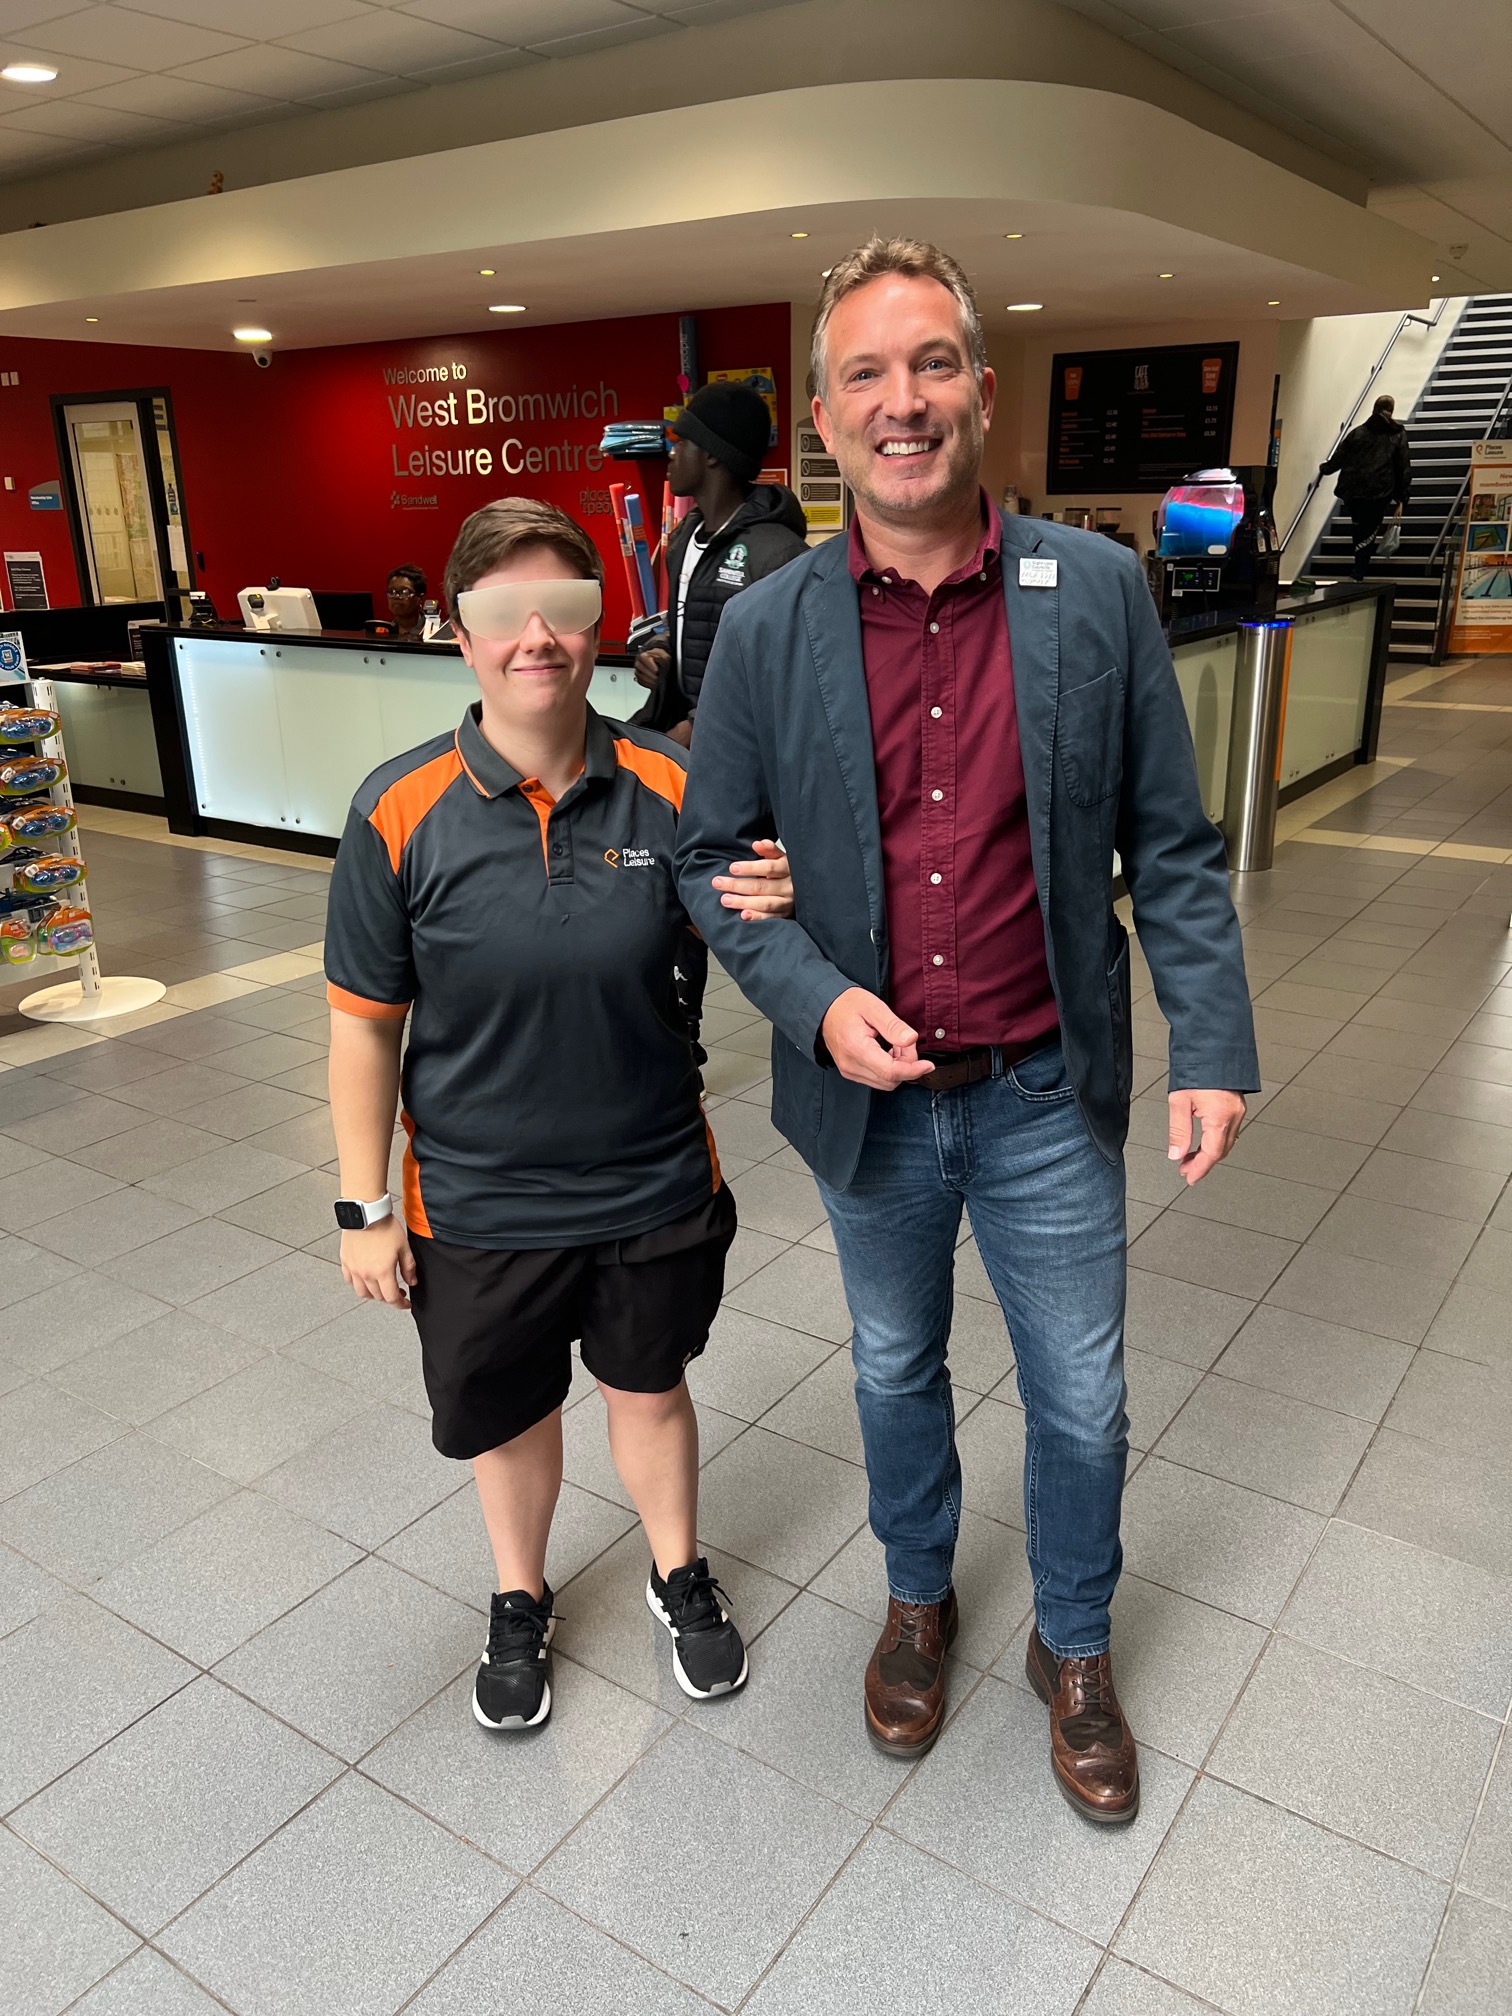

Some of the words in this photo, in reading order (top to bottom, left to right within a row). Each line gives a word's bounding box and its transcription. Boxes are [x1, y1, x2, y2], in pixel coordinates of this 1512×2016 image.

[383, 365, 449, 385] Welcome
[451, 361, 467, 380] to
[388, 391, 459, 429] West
[466, 381, 619, 425] Bromwich
[391, 444, 493, 477] Leisure
[501, 438, 604, 475] Centre
[622, 848, 650, 858] Places
[623, 857, 655, 867] Leisure
